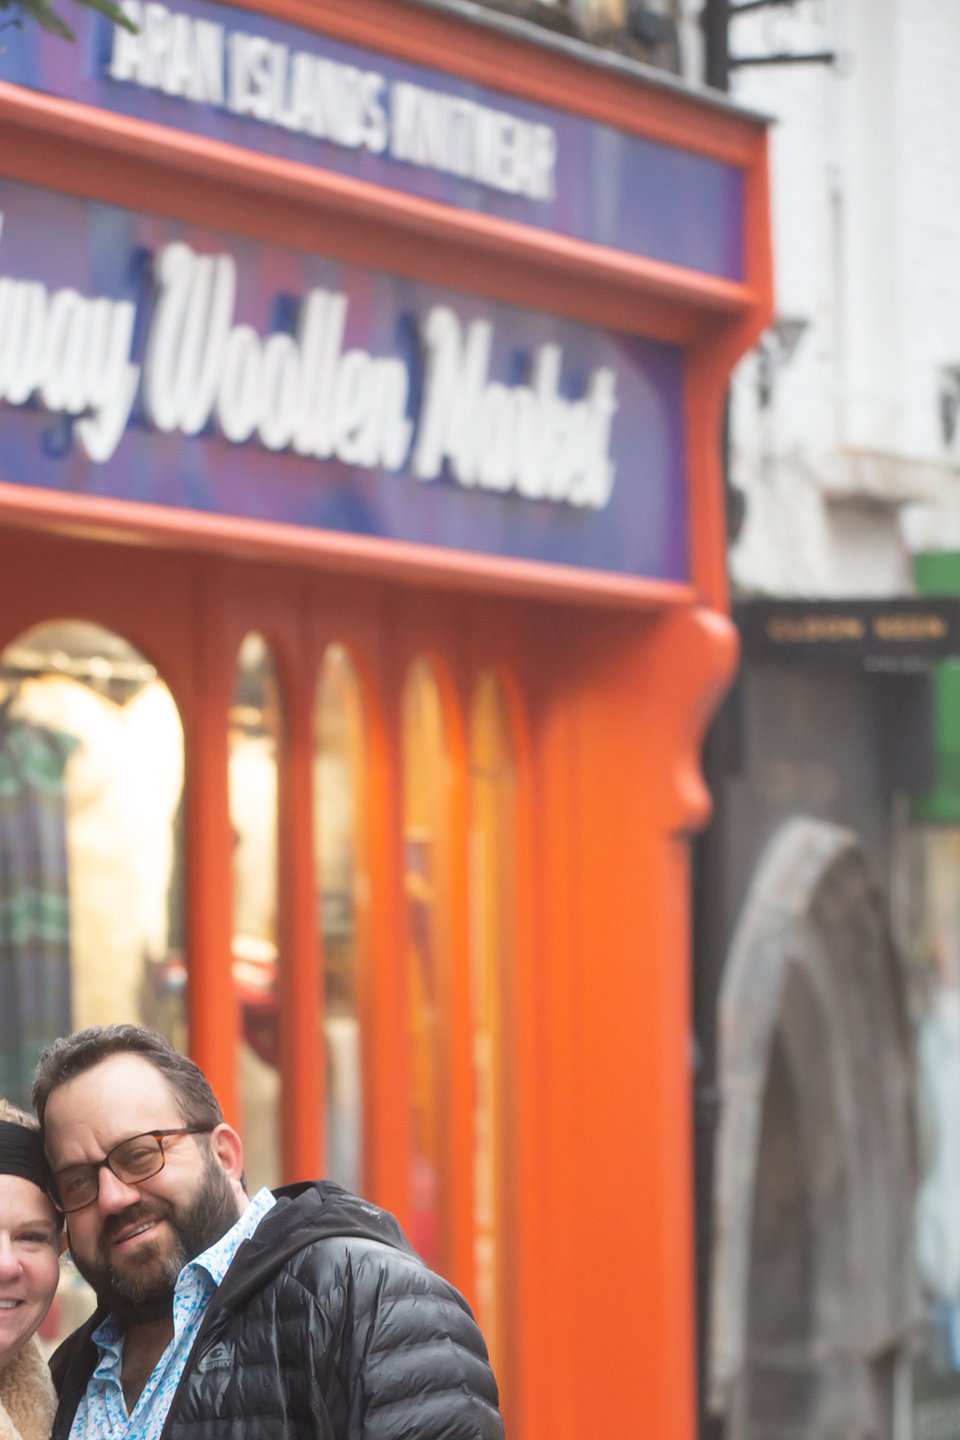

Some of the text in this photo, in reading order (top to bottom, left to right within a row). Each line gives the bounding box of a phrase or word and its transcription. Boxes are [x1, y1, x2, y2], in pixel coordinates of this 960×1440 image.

[110, 0, 556, 200] ARAN ISLANDS KNITWEAR
[146, 242, 413, 471] Woollen
[413, 306, 618, 511] Market
